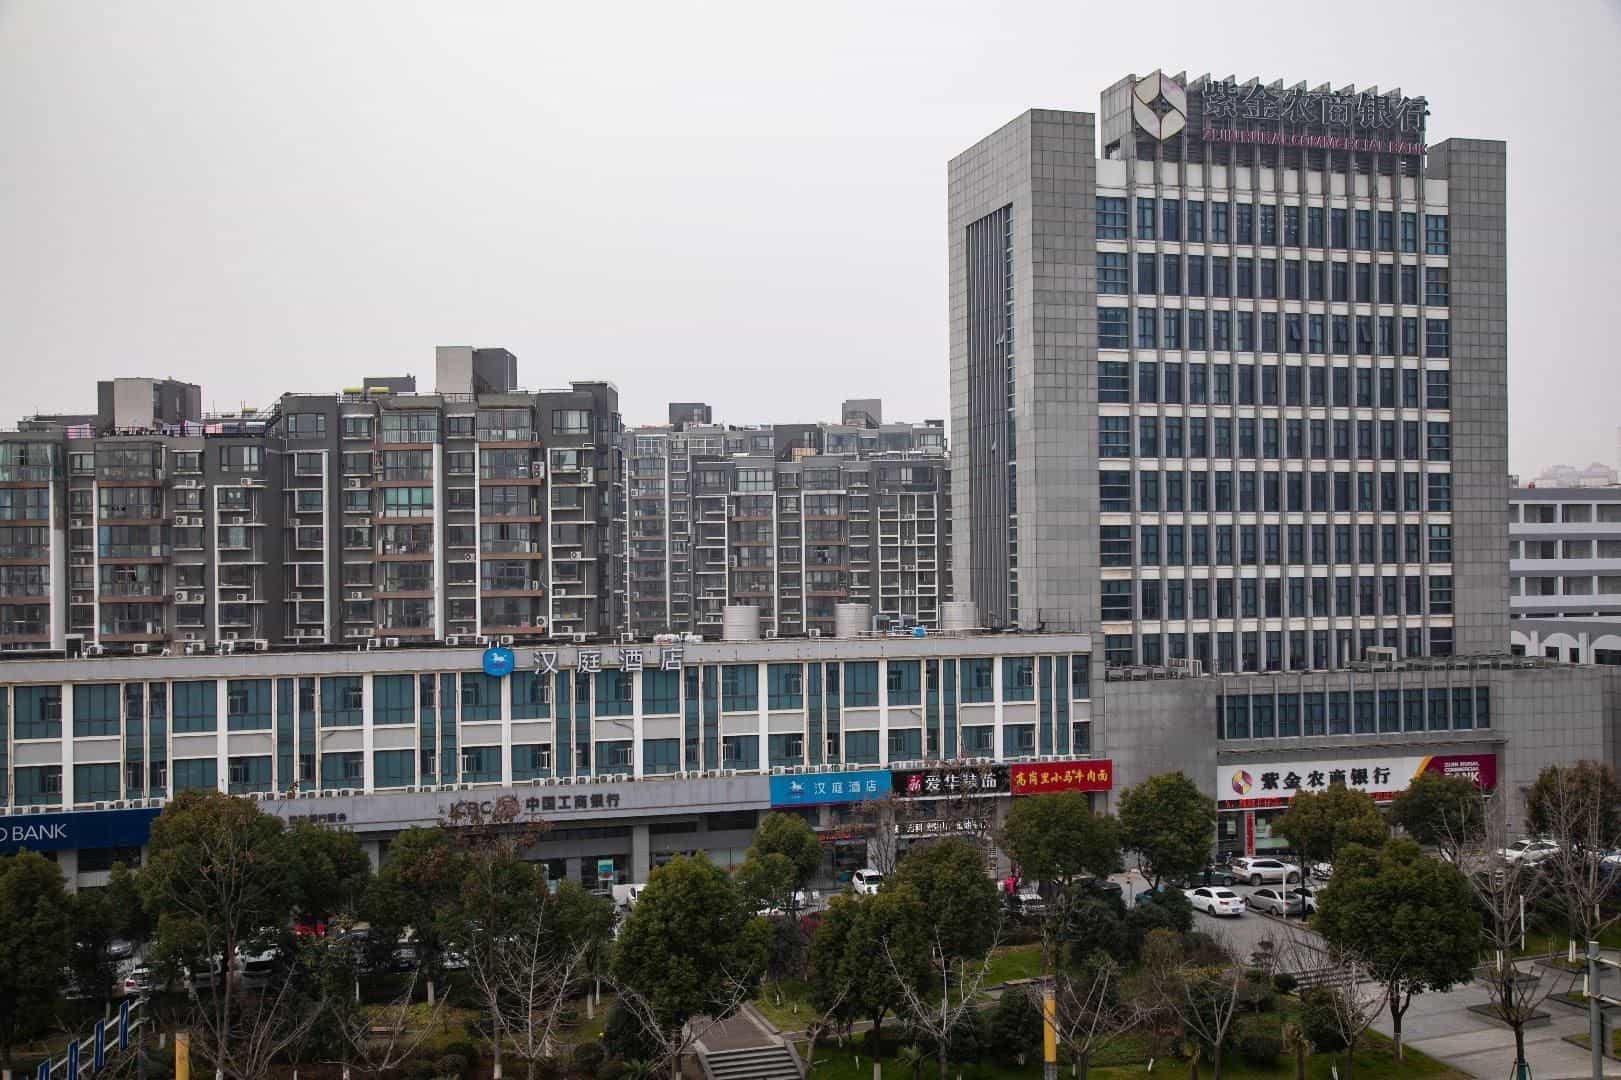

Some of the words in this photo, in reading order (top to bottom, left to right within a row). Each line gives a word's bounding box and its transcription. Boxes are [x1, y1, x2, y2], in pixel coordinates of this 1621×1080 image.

[1202, 80, 1430, 132] 紫金农商银行
[1389, 140, 1428, 155] BANK
[534, 648, 684, 675] 汉庭酒店
[814, 780, 877, 795] 汉庭酒店
[1261, 766, 1391, 790] 紫金农商银行
[526, 793, 620, 812] 中国工商银行
[12, 824, 68, 841] BANK
